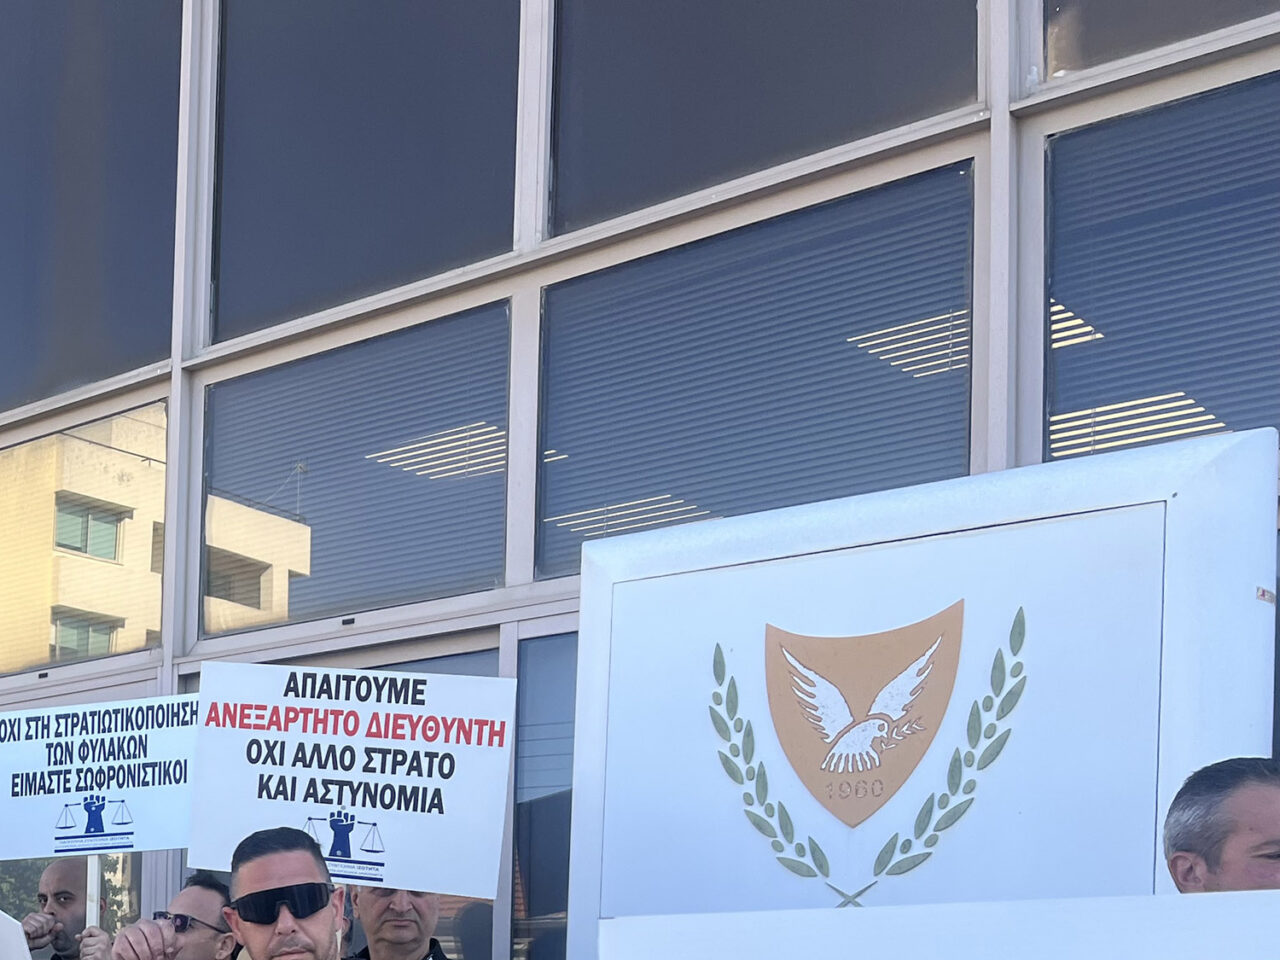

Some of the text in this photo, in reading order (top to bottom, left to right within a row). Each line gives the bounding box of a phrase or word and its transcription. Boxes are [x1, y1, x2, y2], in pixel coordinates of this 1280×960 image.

[283, 671, 427, 706] ΑΠΑΙΤΟΥΜΕ
[25, 715, 51, 741] ΣΤΗ
[54, 700, 199, 738] ΣΤΡΑΤΙΩΤΙΚΟΠΟΙΗΣΗ
[204, 701, 506, 748] ΑΝΕΞΑΡΤΗΤΟ ΔΙΕΥΘΥΝΤΗ
[45, 734, 148, 767] ΤΩΝ ΦΥΛΑΚΩΝ
[246, 738, 455, 780] ΟΧΙ ΑΛΛΟ ΣΤΡΑΤΟ
[11, 759, 188, 797] ΕΙΜΑΣΤΕ ΣΩΦΡΟΝΙΣΤΙΚΟΙ
[257, 773, 445, 815] ΚΑΙ ΑΣΤΥΝΟΜΙΑ
